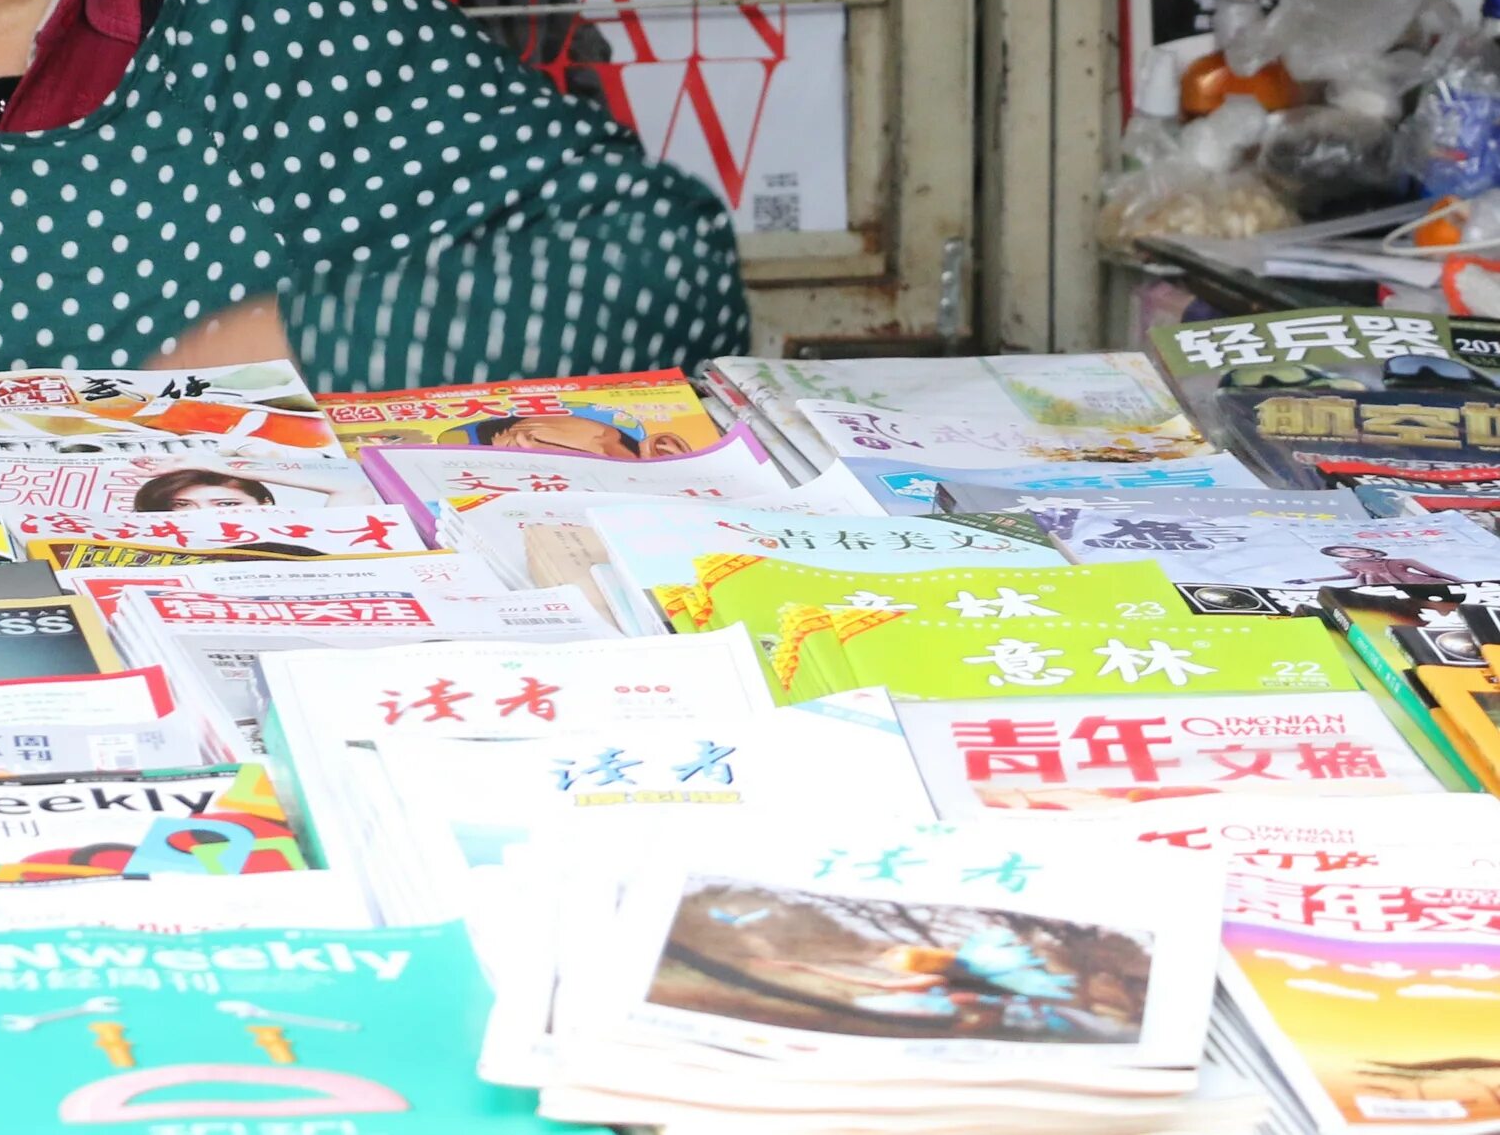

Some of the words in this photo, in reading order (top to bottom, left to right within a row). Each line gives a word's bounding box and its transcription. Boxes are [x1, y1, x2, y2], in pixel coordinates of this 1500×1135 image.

[1173, 314, 1450, 368] 轻兵器
[326, 394, 573, 424] 幽默大王
[163, 599, 423, 623] 特别关注
[1117, 601, 1167, 619] 23
[961, 635, 1220, 688] 意林
[1269, 660, 1325, 677] 22
[376, 676, 562, 726] 读者
[1181, 714, 1346, 736] QINGNIAN
[1224, 724, 1347, 737] WENZHAI
[549, 740, 739, 791] 读者
